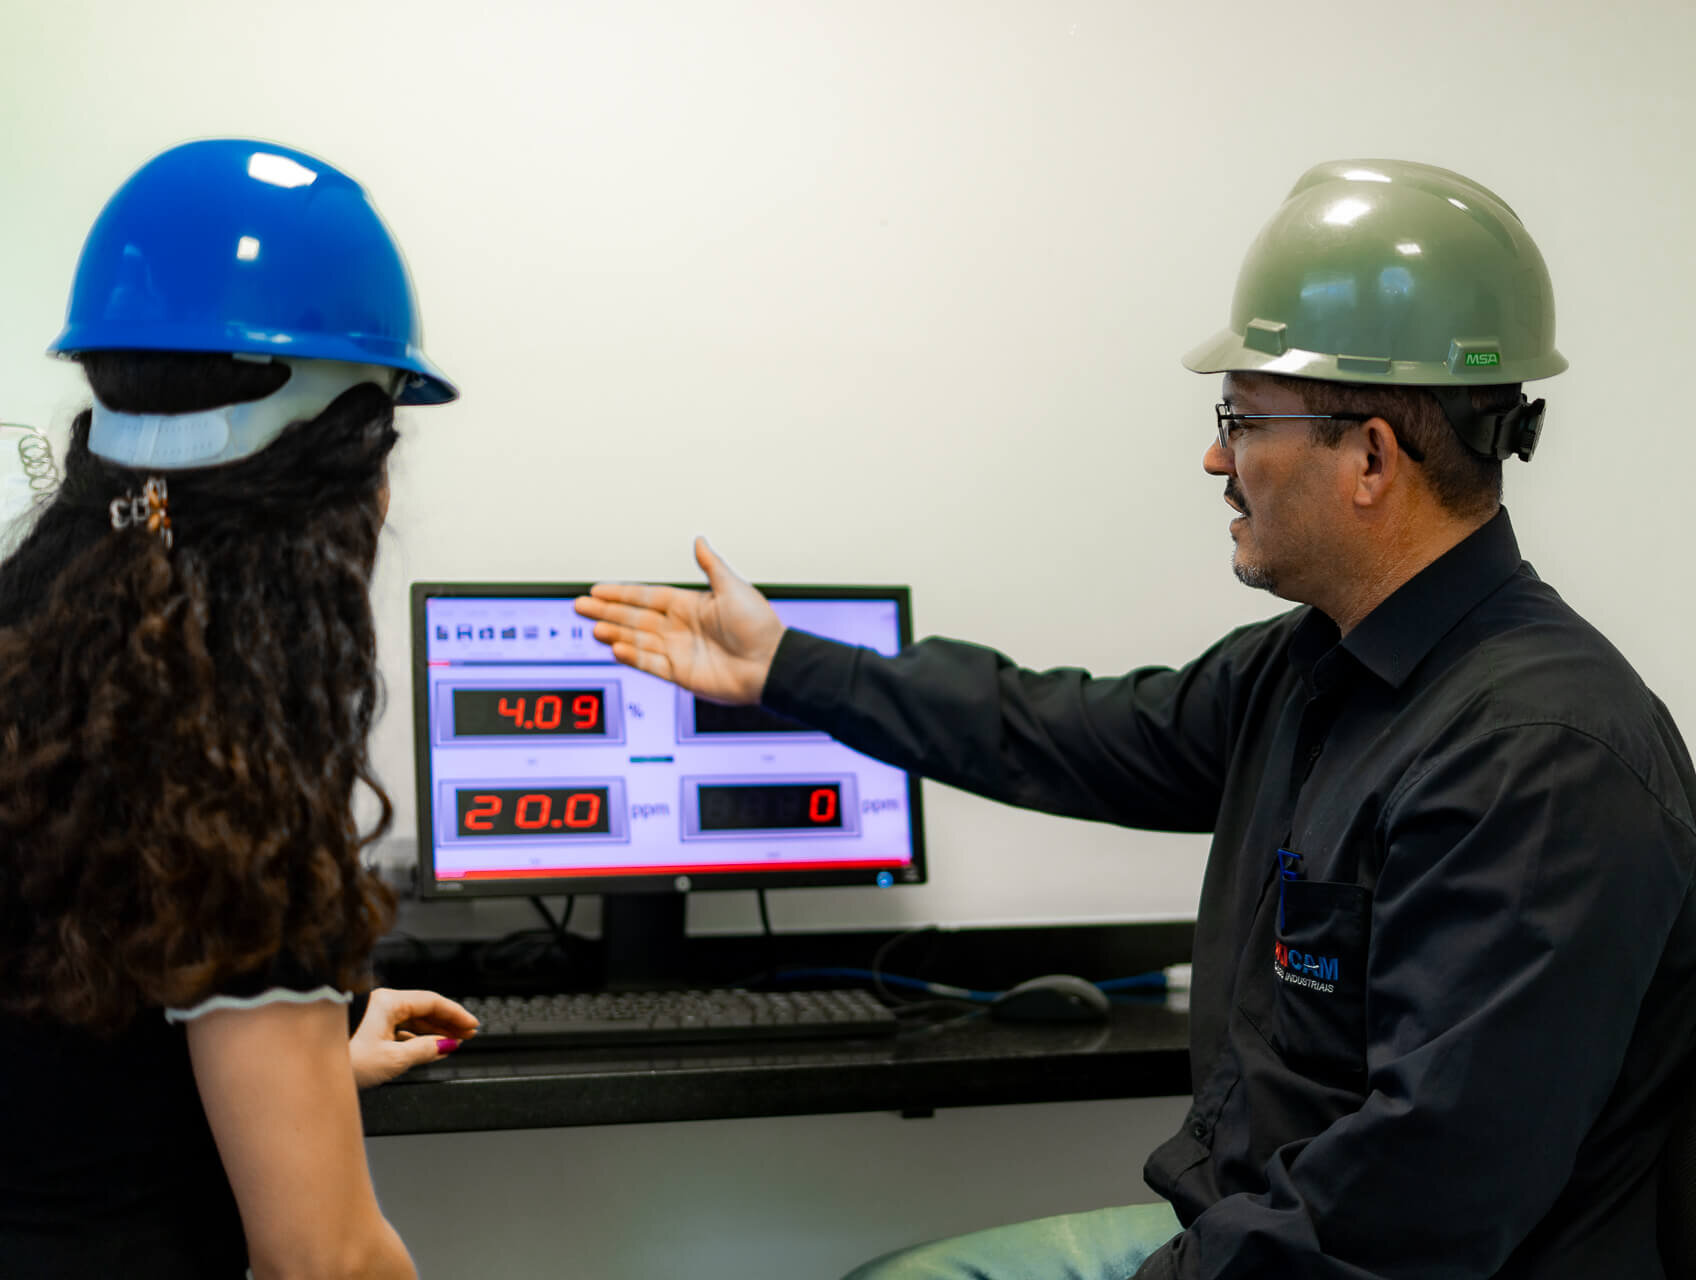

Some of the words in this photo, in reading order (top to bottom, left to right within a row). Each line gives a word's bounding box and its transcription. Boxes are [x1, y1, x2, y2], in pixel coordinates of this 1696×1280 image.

[1466, 353, 1498, 365] MSA
[498, 695, 599, 730] 4.09
[464, 793, 600, 830] 20.0
[631, 803, 671, 819] ppm
[809, 789, 837, 823] 0
[862, 798, 899, 814] ppm
